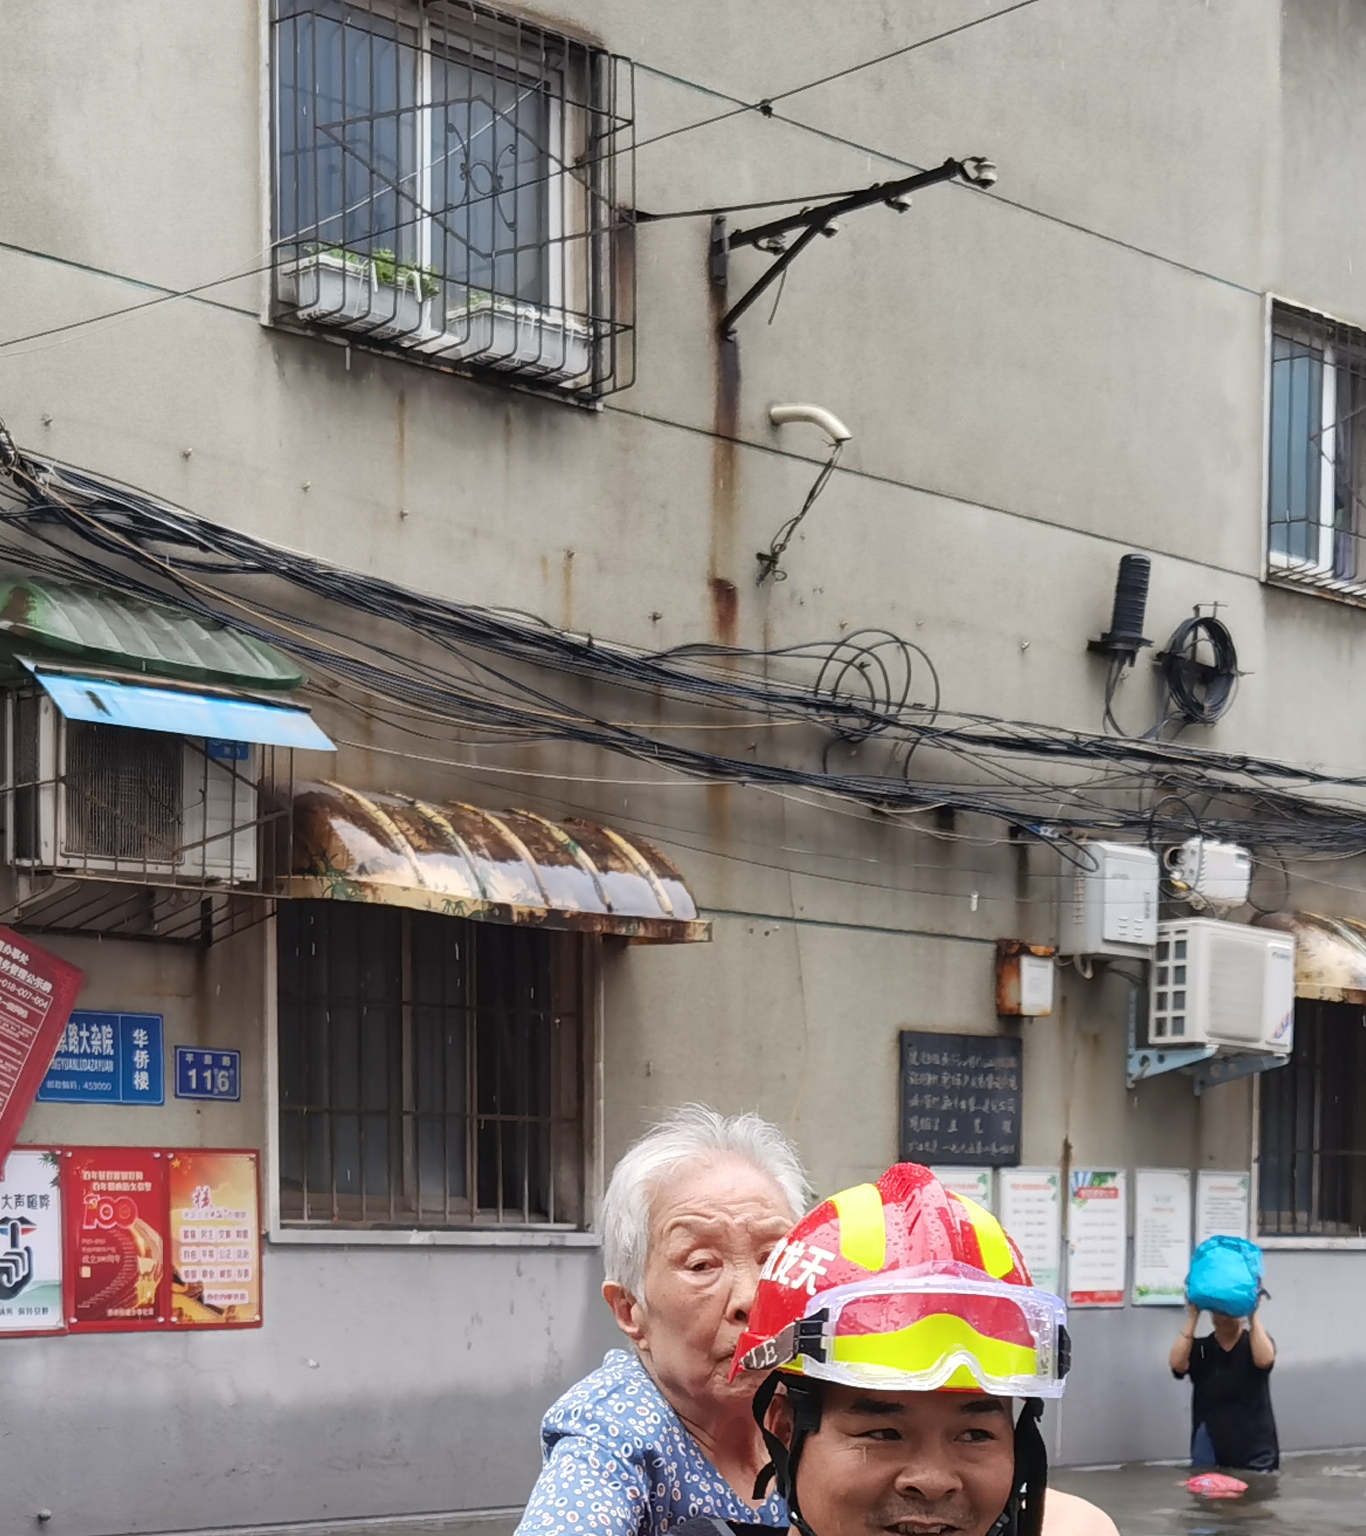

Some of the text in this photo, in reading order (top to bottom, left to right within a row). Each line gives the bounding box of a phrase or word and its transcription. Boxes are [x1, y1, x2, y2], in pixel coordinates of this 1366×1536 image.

[132, 1028, 150, 1091] 华侨楼
[188, 1068, 230, 1092] 116
